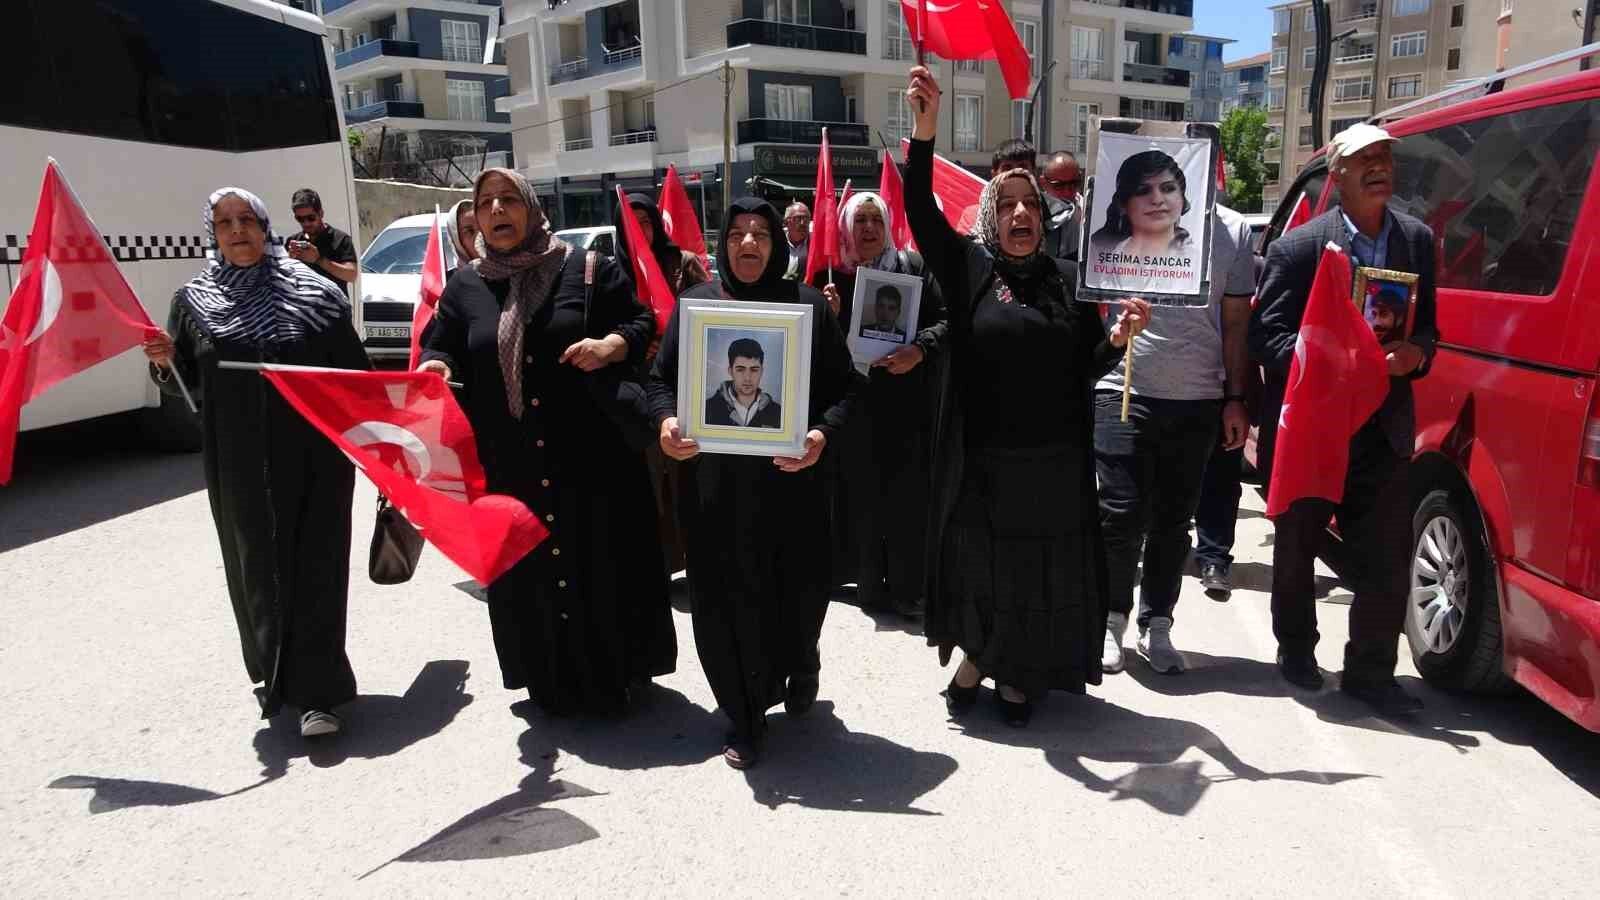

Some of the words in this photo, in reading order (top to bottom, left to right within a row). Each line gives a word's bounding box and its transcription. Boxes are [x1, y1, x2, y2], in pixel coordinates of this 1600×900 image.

[1098, 252, 1140, 264] ŞERİMA
[1143, 255, 1191, 267] SANCAR
[1093, 264, 1137, 276] EVLADIMI
